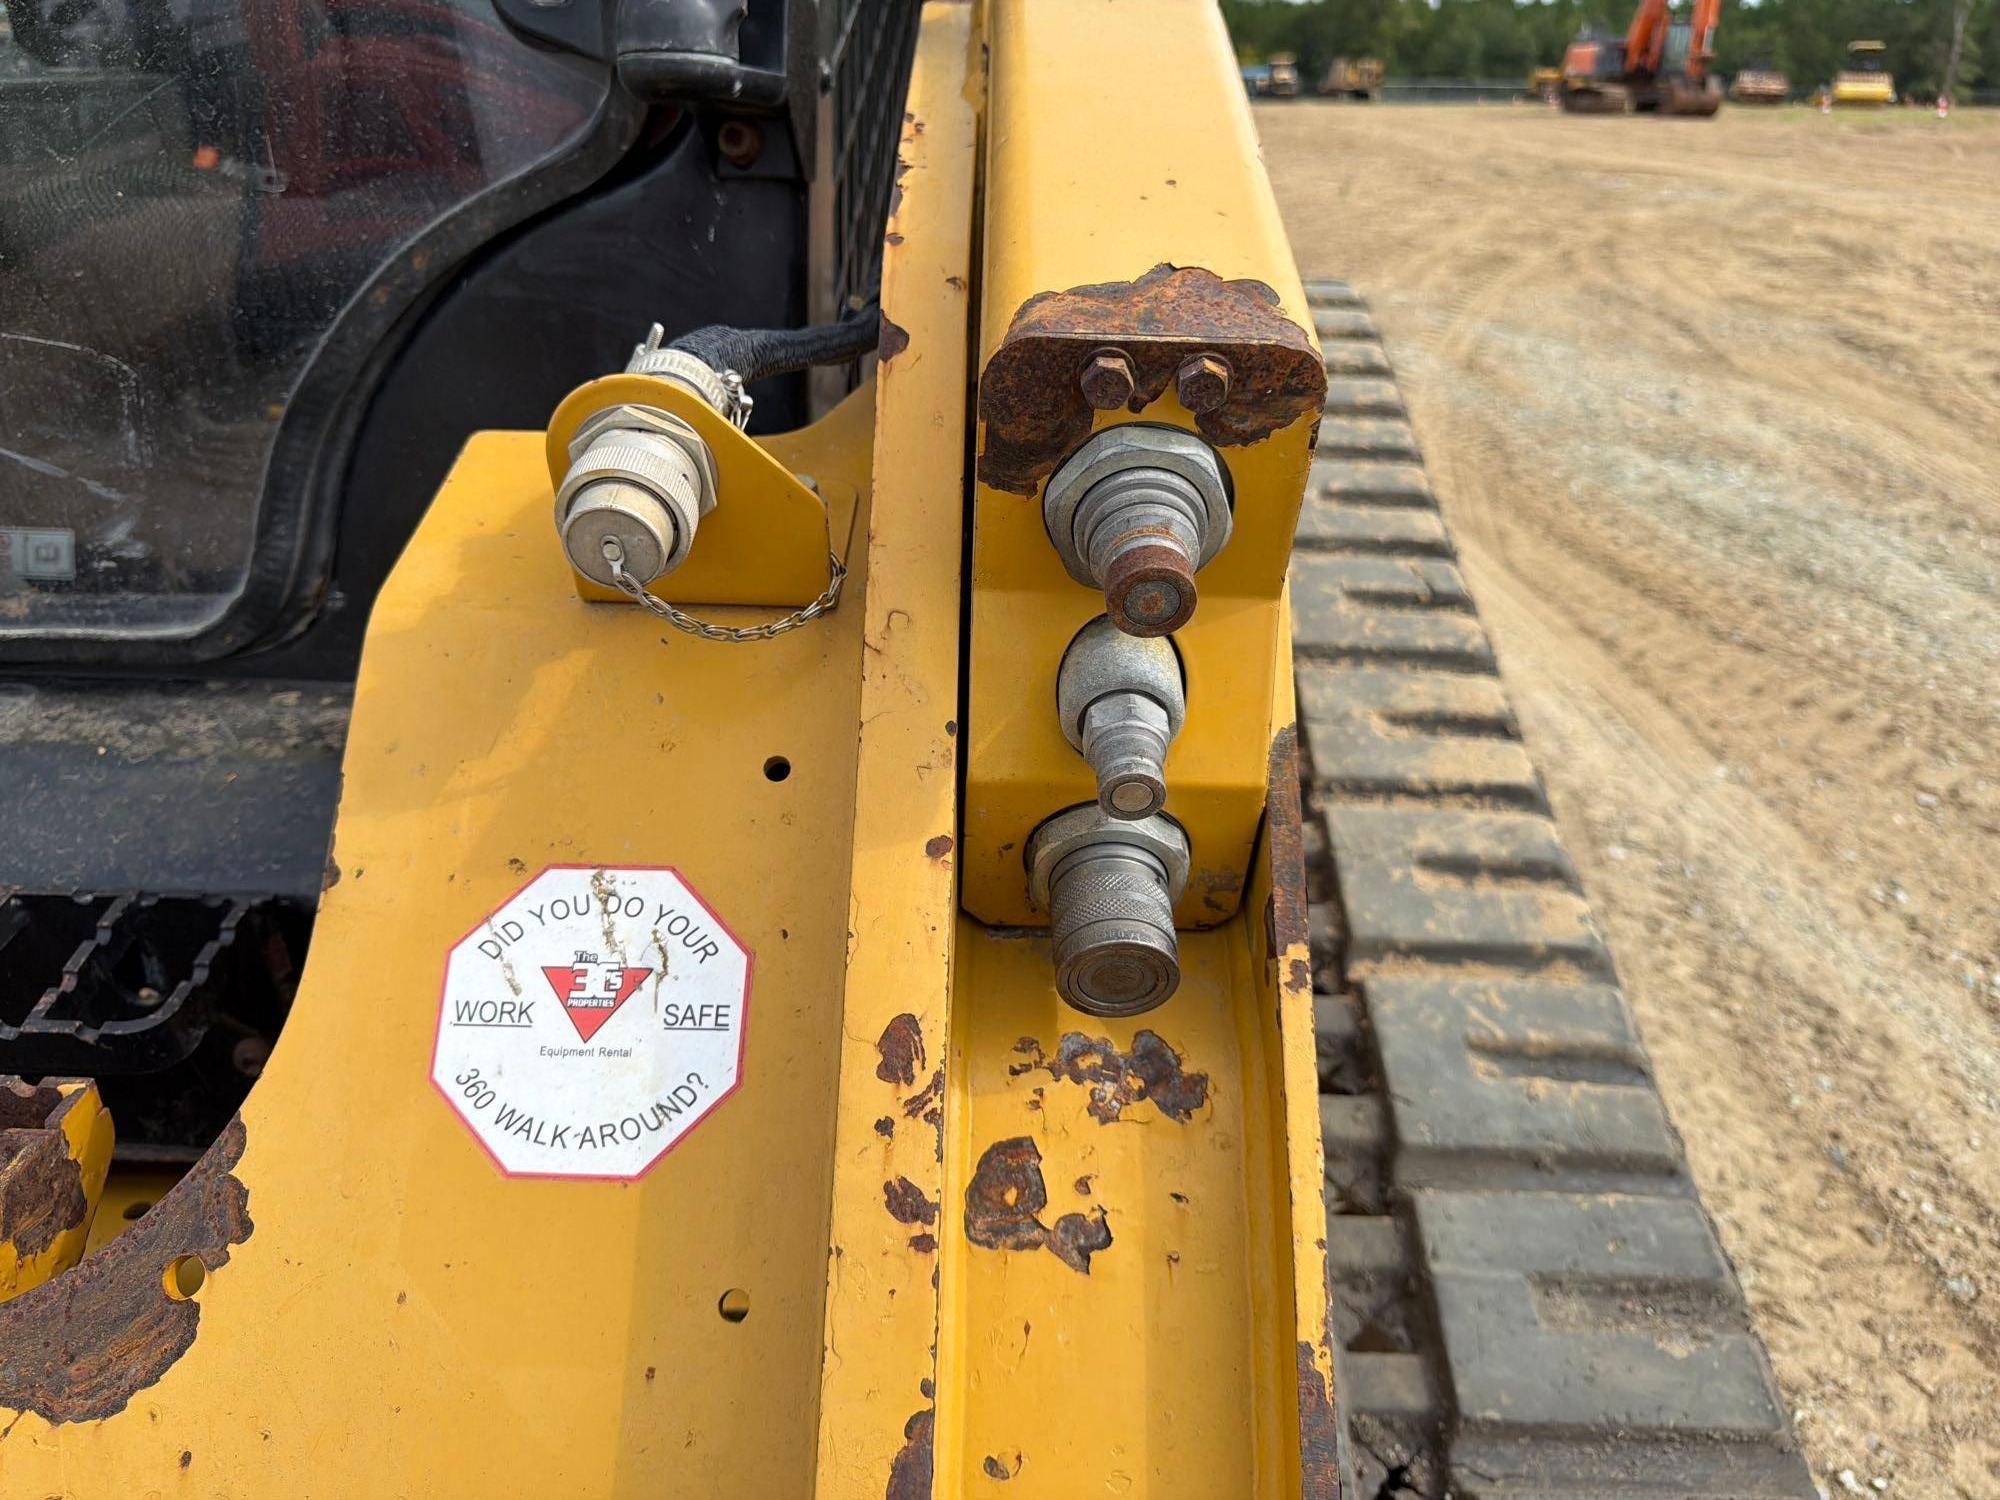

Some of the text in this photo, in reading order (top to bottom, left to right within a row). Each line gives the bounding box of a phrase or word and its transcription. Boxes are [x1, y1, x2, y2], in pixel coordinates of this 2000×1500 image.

[478, 894, 719, 964] DID YOU DO YOUR
[574, 950, 598, 963] The
[454, 1000, 731, 1028] WORK SAFE
[540, 1045, 633, 1059] Equipment Rental
[455, 1068, 709, 1150] 360 WALK AROUND?
